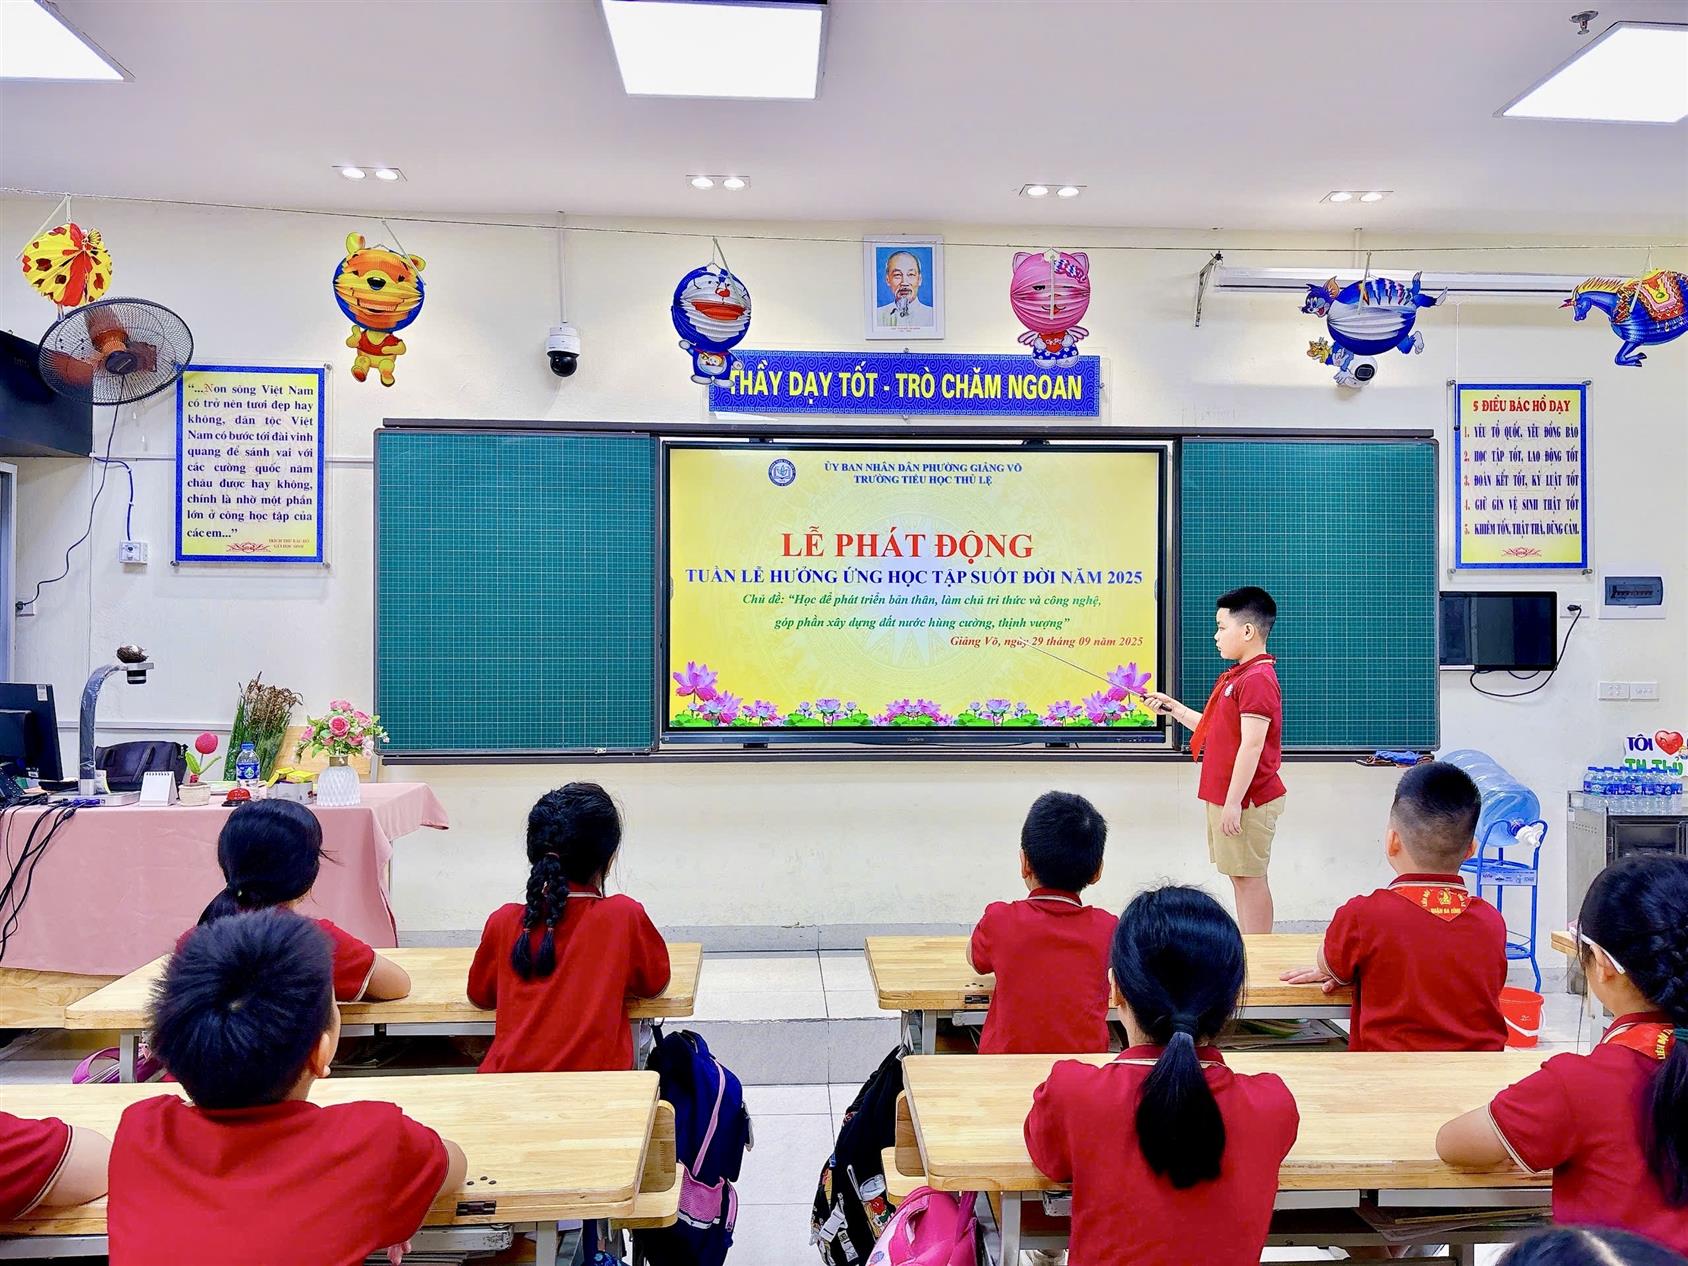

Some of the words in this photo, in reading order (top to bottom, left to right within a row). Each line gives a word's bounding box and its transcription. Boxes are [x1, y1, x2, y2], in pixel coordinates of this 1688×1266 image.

[729, 360, 783, 395] THẦY
[789, 371, 833, 404] DẠY
[838, 361, 878, 398] TỐT
[895, 366, 936, 399] TRÒ
[941, 367, 1002, 399] CHĂM
[1008, 372, 1082, 400] NGOAN
[232, 385, 256, 396] sông
[262, 385, 283, 397] Việt
[288, 385, 314, 395] Nam
[188, 399, 200, 408] có
[204, 398, 220, 408] trở
[223, 400, 242, 409] nên
[246, 399, 267, 409] tươi
[271, 400, 291, 412] đẹp
[294, 401, 313, 412] hay
[1473, 400, 1478, 412] 5
[1482, 394, 1507, 412] ĐIỀU
[1509, 396, 1530, 412] BÁC
[1532, 394, 1547, 412] HỒ
[1549, 400, 1571, 415] DẠY
[188, 414, 226, 426] không,
[234, 415, 256, 425] dân
[265, 416, 282, 427] tộc
[291, 416, 313, 426] Việt
[188, 430, 213, 440] Nam
[214, 431, 227, 440] có
[229, 431, 254, 441] bước
[256, 431, 270, 441] tới
[272, 431, 288, 441] đài
[290, 432, 313, 442] vinh
[187, 449, 221, 458] quang
[226, 445, 240, 456] để
[245, 447, 270, 457] sánh
[276, 447, 292, 457] vai
[298, 448, 313, 457] với
[187, 463, 205, 472] các
[214, 463, 246, 474] cường
[255, 463, 281, 475] quốc
[290, 465, 313, 473] năm
[824, 461, 839, 471] ỦY
[842, 463, 863, 472] BAN
[866, 461, 895, 473] NHÂN
[898, 461, 920, 472] DÂN
[922, 462, 968, 472] PHƯỜNG
[970, 462, 1004, 473] GIẢNG
[1007, 463, 1022, 472] VÕ
[187, 478, 212, 488] châu
[219, 478, 245, 489] được
[252, 479, 270, 491] hay
[277, 480, 313, 491] không,
[854, 474, 899, 484] TRƯỜNG
[901, 474, 926, 484] TIỂU
[929, 476, 952, 486] HỌC
[954, 474, 976, 484] THỦ
[979, 475, 992, 486] LỆ
[187, 494, 217, 503] chính
[222, 494, 231, 504] là
[236, 495, 256, 504] nhờ
[261, 496, 281, 506] một
[286, 495, 312, 507] phần
[187, 510, 204, 519] lớn
[208, 509, 216, 520] ở
[219, 510, 244, 522] công
[249, 511, 268, 522] học
[272, 511, 290, 523] tập
[294, 511, 312, 521] của
[186, 528, 204, 538] các
[782, 526, 824, 557] LỄ
[835, 526, 926, 557] PHÁT
[934, 530, 1033, 565] ĐỘNG
[686, 566, 736, 583] TUẦN
[742, 566, 764, 583] LỄ
[770, 566, 838, 583] HƯỞNG
[844, 566, 882, 584] ỨNG
[888, 570, 928, 587] HỌC
[932, 569, 967, 588] TẬP
[970, 567, 1018, 584] SUỐT
[1024, 567, 1055, 584] ĐỜI
[1061, 568, 1102, 584] NĂM
[1108, 571, 1142, 584] 2025
[742, 594, 766, 604] Chủ
[768, 593, 784, 604] đề:
[819, 593, 832, 604] để
[833, 594, 859, 607] phát
[860, 593, 886, 605] triển
[888, 594, 908, 604] bản
[911, 594, 938, 607] thân,
[941, 594, 962, 605] làm
[964, 594, 984, 605] chủ
[986, 595, 1000, 605] tri
[1002, 595, 1026, 605] thức
[1029, 595, 1041, 605] và
[1044, 595, 1070, 607] công
[1072, 595, 1101, 607] nghệ,
[774, 617, 795, 630] góp
[796, 616, 825, 630] phần
[826, 617, 846, 630] xây
[848, 617, 876, 630] dựng
[878, 616, 896, 627] đất
[898, 617, 926, 627] nước
[928, 617, 956, 630] hùng
[958, 618, 995, 630] cường,
[998, 617, 1026, 630] thịnh
[1030, 618, 1070, 630] vượng”
[950, 636, 981, 648] Giảng
[985, 636, 1001, 647] Võ,
[1030, 636, 1044, 647] 29
[1046, 636, 1076, 648] tháng
[1078, 637, 1091, 646] 09
[1093, 637, 1116, 646] năm
[1119, 637, 1143, 646] 2025
[1626, 733, 1654, 752] TÔI
